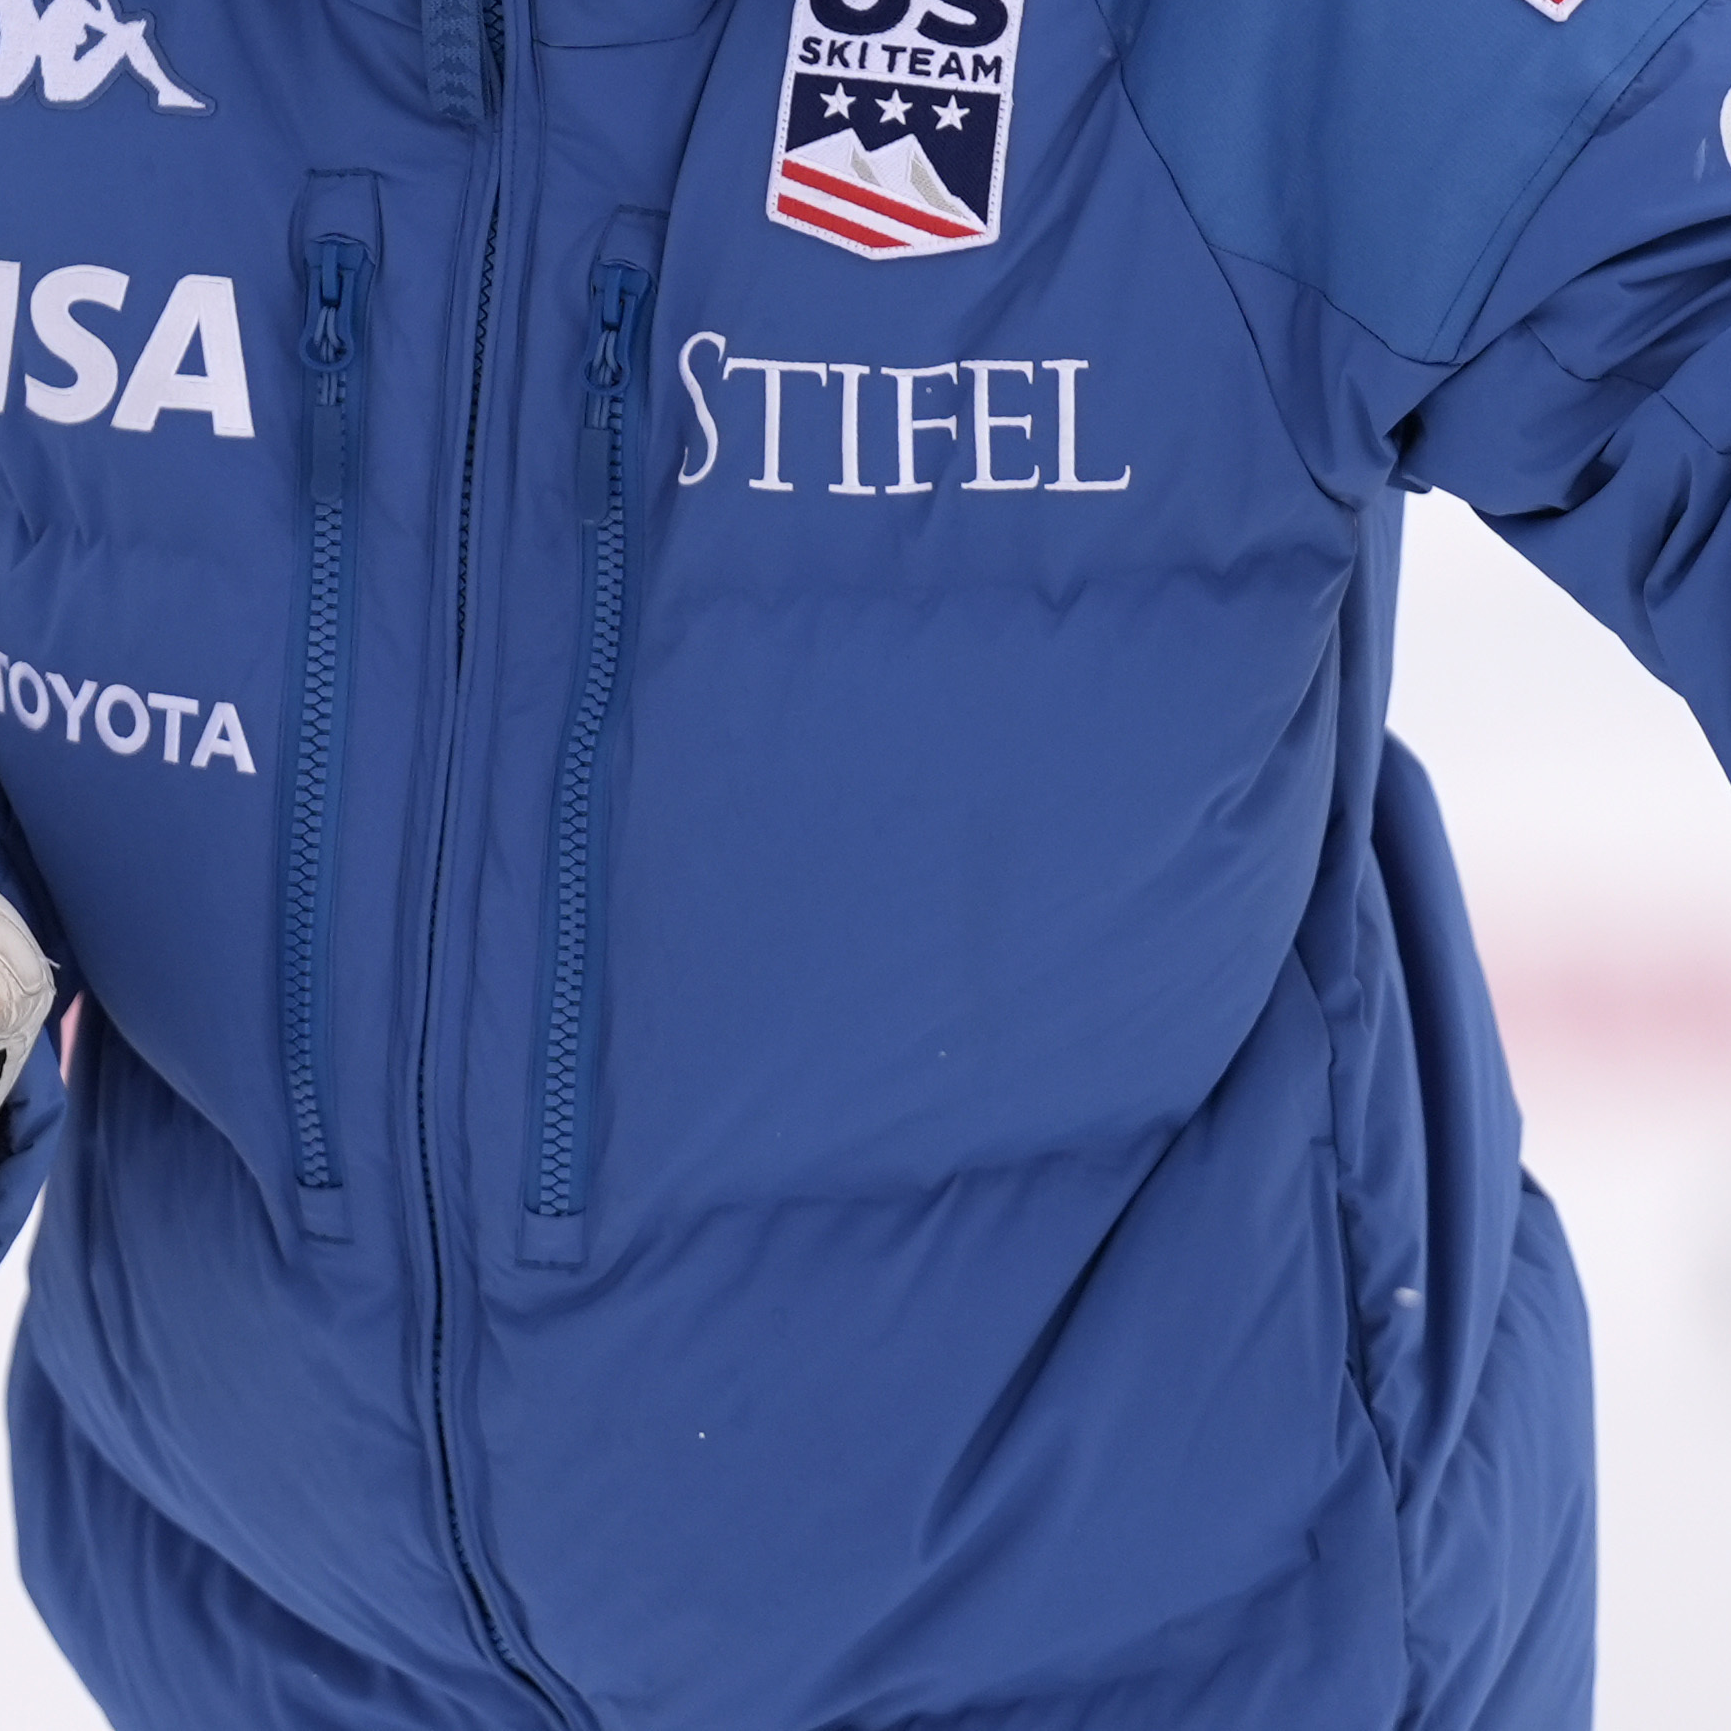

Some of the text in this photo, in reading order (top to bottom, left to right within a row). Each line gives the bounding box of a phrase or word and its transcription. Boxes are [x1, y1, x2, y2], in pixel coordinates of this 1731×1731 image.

[798, 36, 1003, 84] SKI TEAM
[677, 331, 1131, 495] STIFEL
